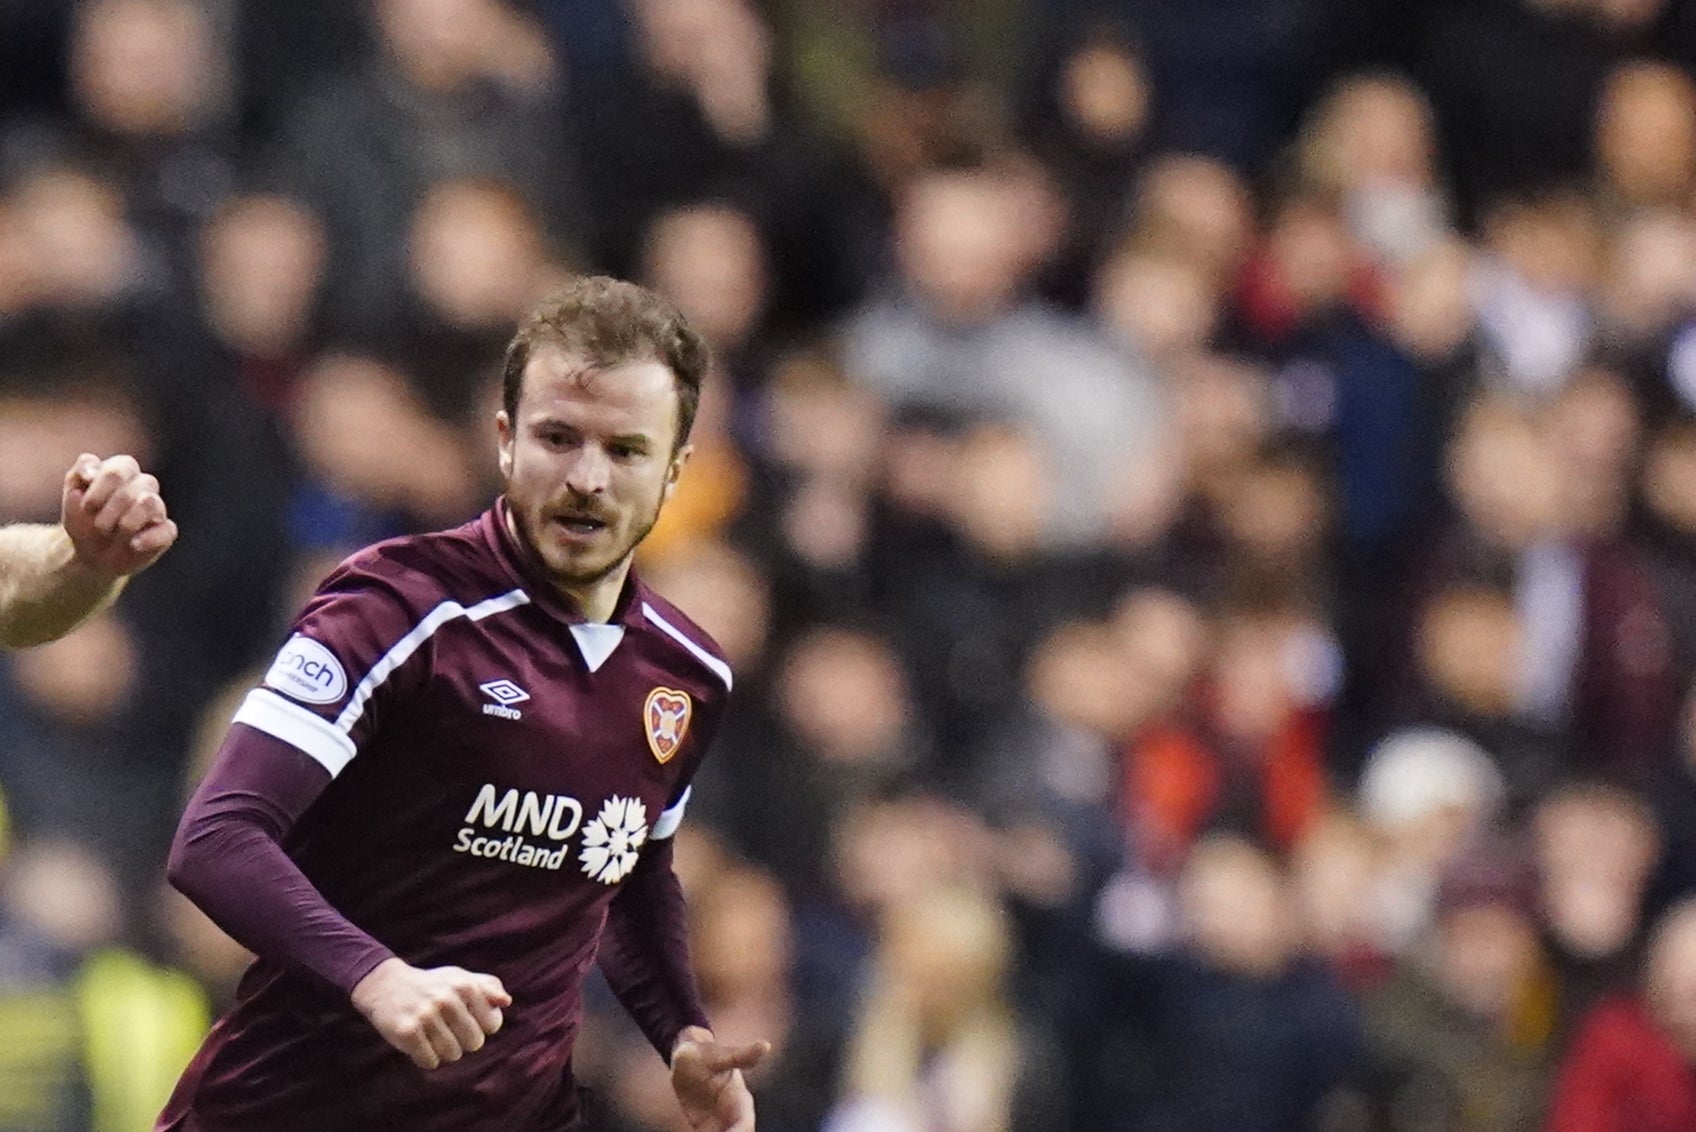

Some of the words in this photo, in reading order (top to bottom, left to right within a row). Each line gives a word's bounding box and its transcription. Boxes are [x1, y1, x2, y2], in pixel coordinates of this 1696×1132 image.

[482, 703, 522, 721] umbro
[464, 783, 583, 841] MND
[453, 827, 569, 870] Scotland
